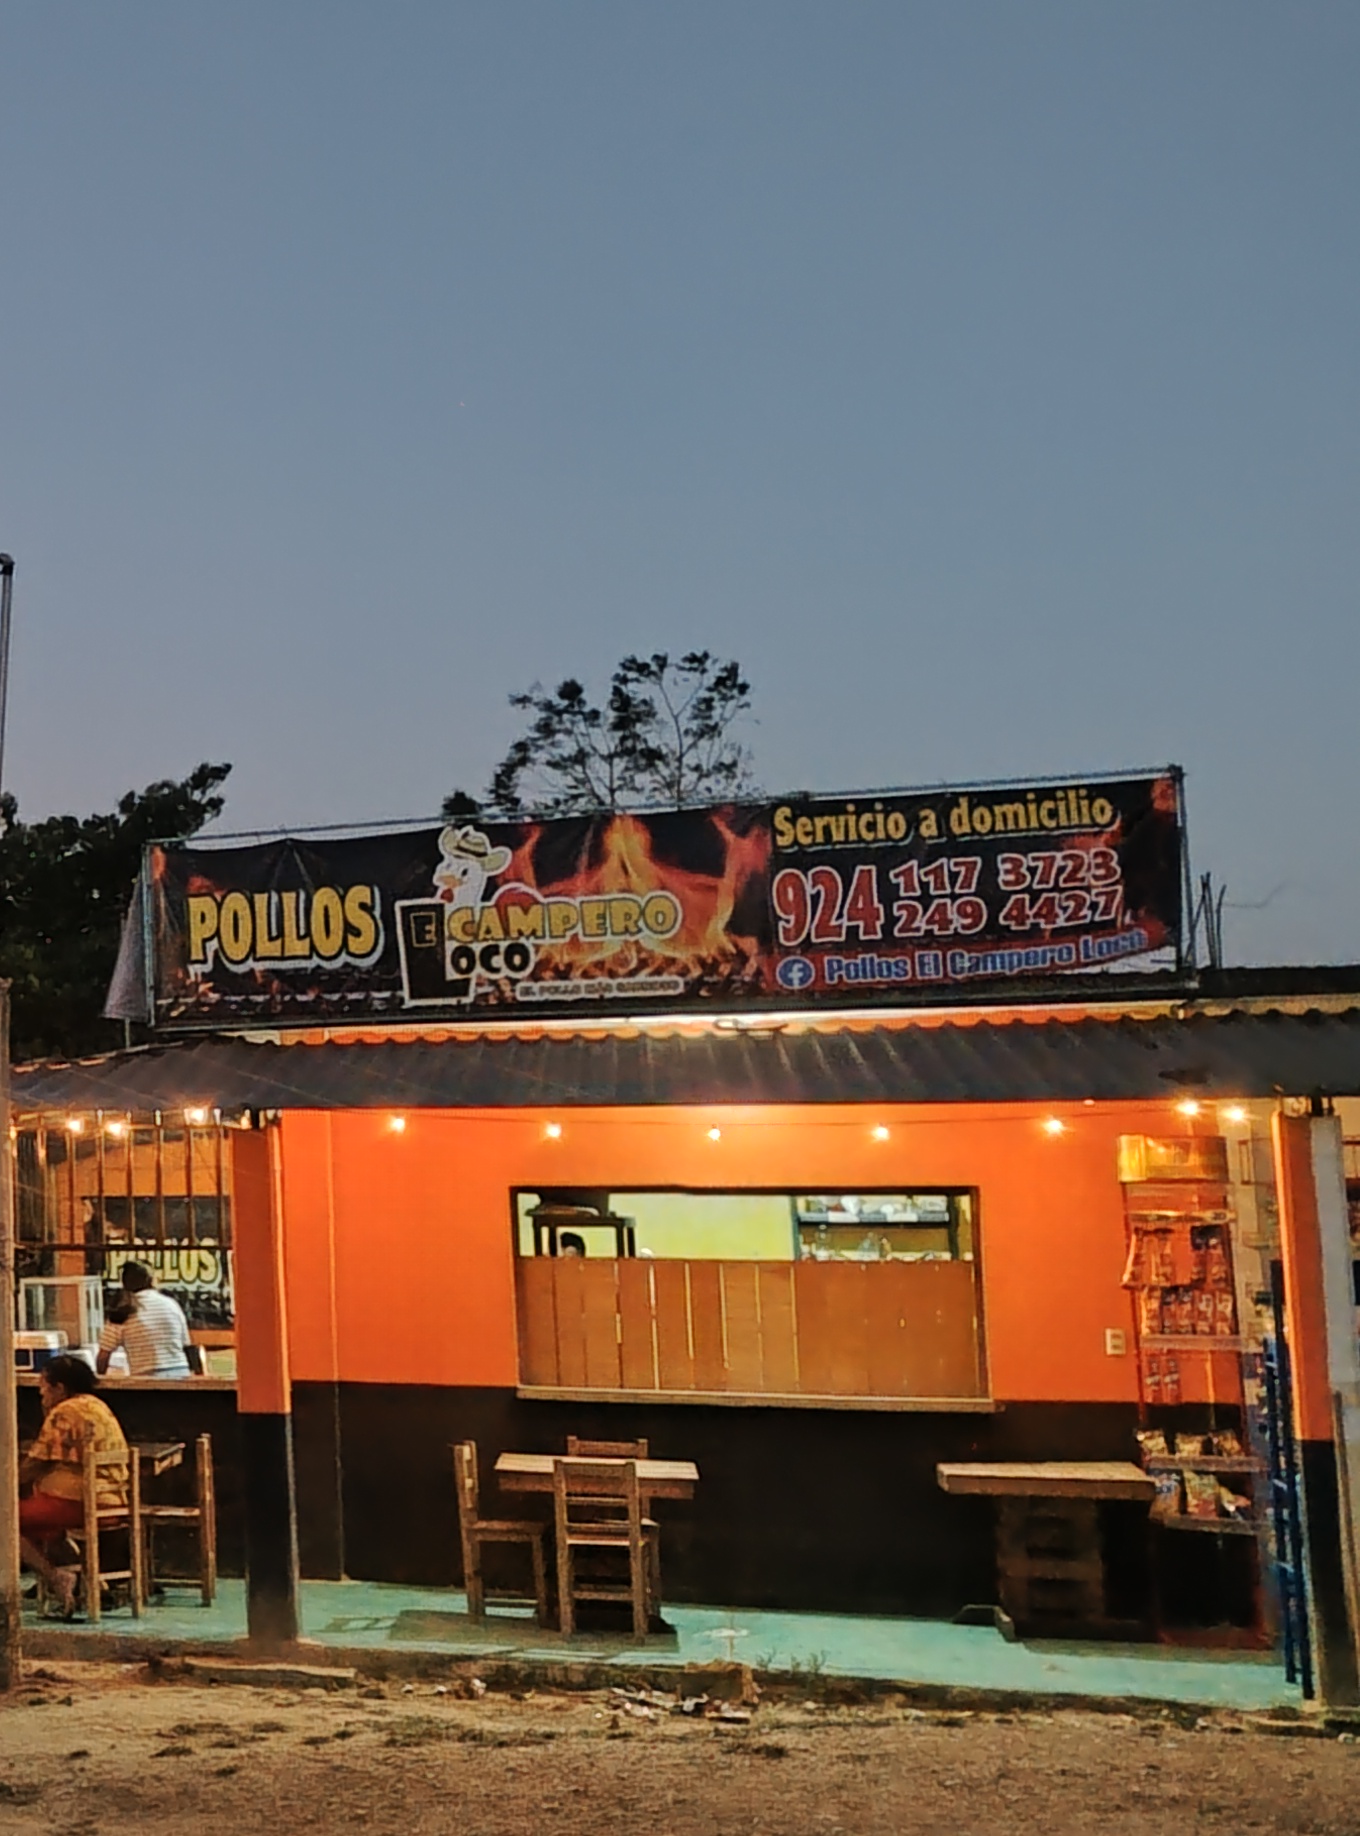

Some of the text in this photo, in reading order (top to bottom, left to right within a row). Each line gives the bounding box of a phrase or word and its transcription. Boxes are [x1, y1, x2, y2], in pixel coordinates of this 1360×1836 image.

[773, 788, 1114, 847] Servicio a domicilio
[446, 894, 680, 944] CAMPERO
[773, 847, 1122, 946] 924 117 3723
[893, 885, 1123, 938] 249 4427
[187, 884, 384, 972] POLLOS
[824, 953, 912, 984] Pollos
[914, 949, 943, 980] El
[948, 942, 1076, 977] Campero
[1079, 927, 1149, 963] Loco
